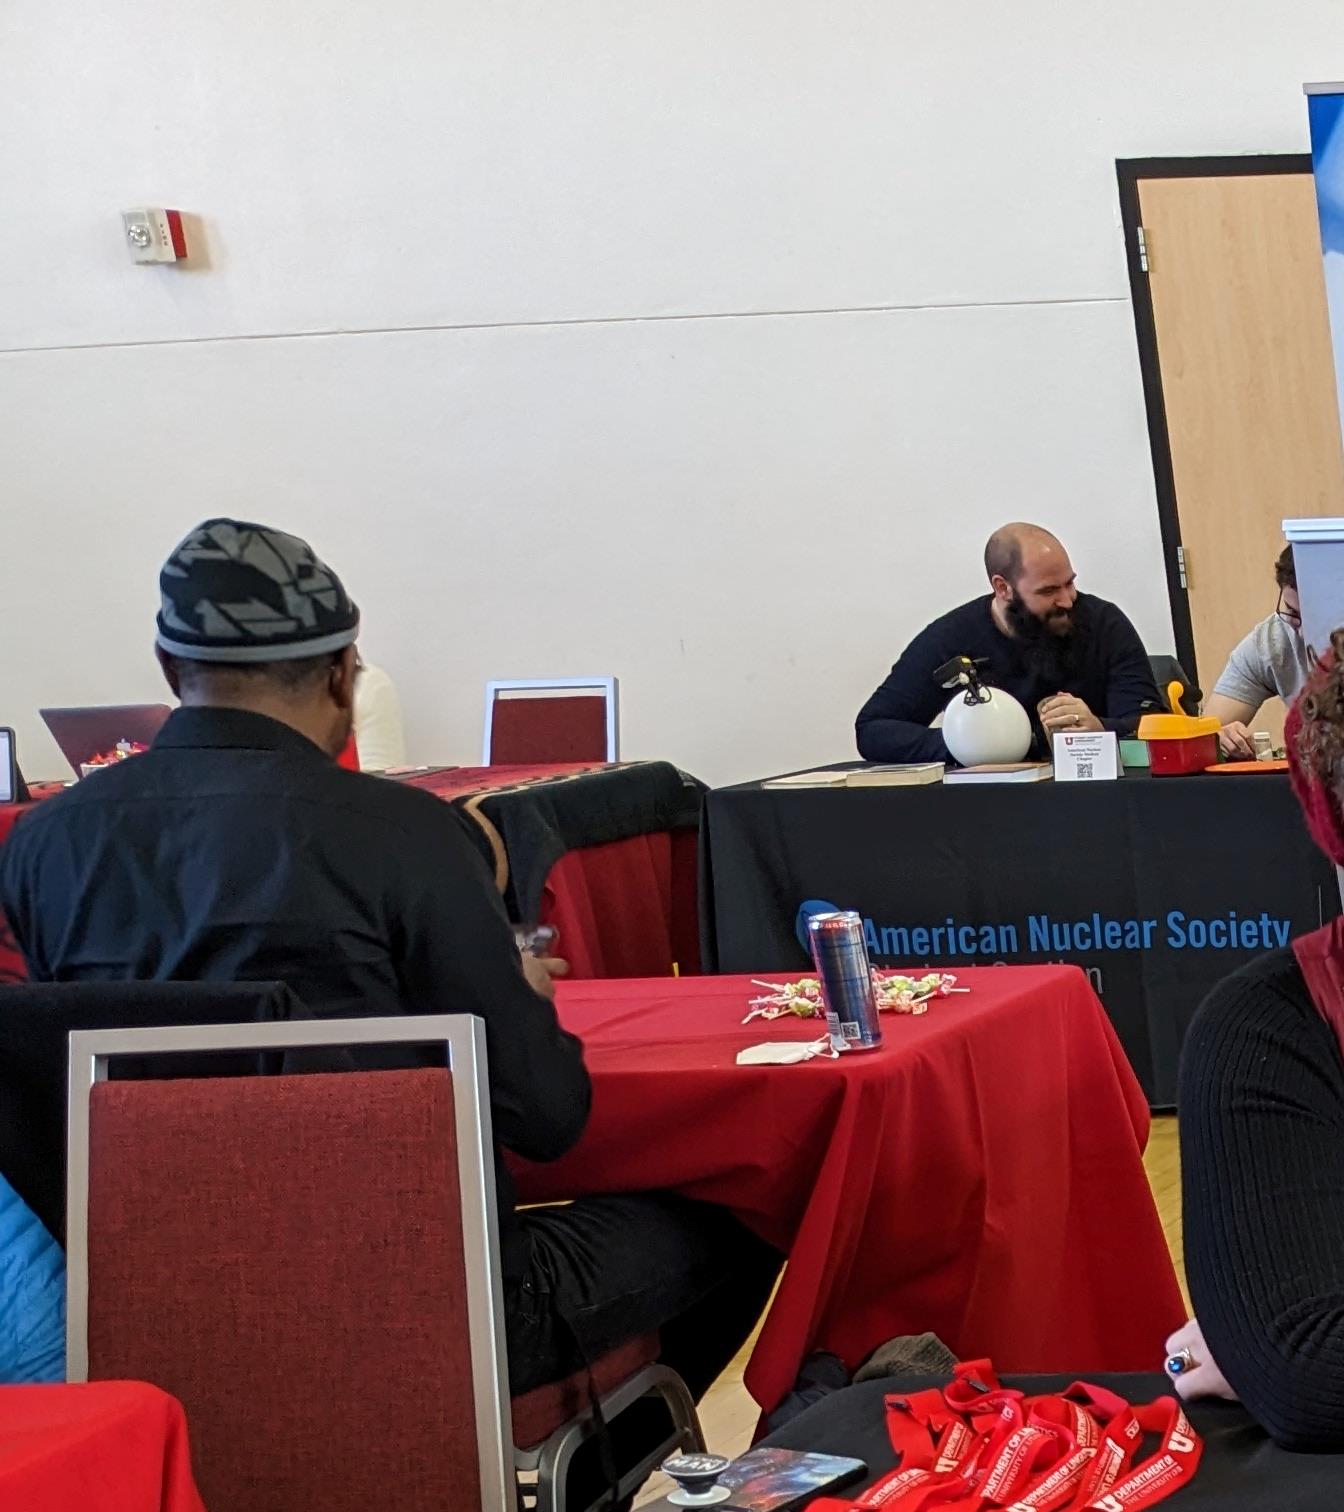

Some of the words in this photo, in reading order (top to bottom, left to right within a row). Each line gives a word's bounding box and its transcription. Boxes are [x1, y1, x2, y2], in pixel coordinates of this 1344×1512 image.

[866, 917, 1019, 956] American
[1029, 914, 1158, 952] Nuclear
[1167, 911, 1291, 950] Society
[1113, 1458, 1168, 1500] DEPARTMENT
